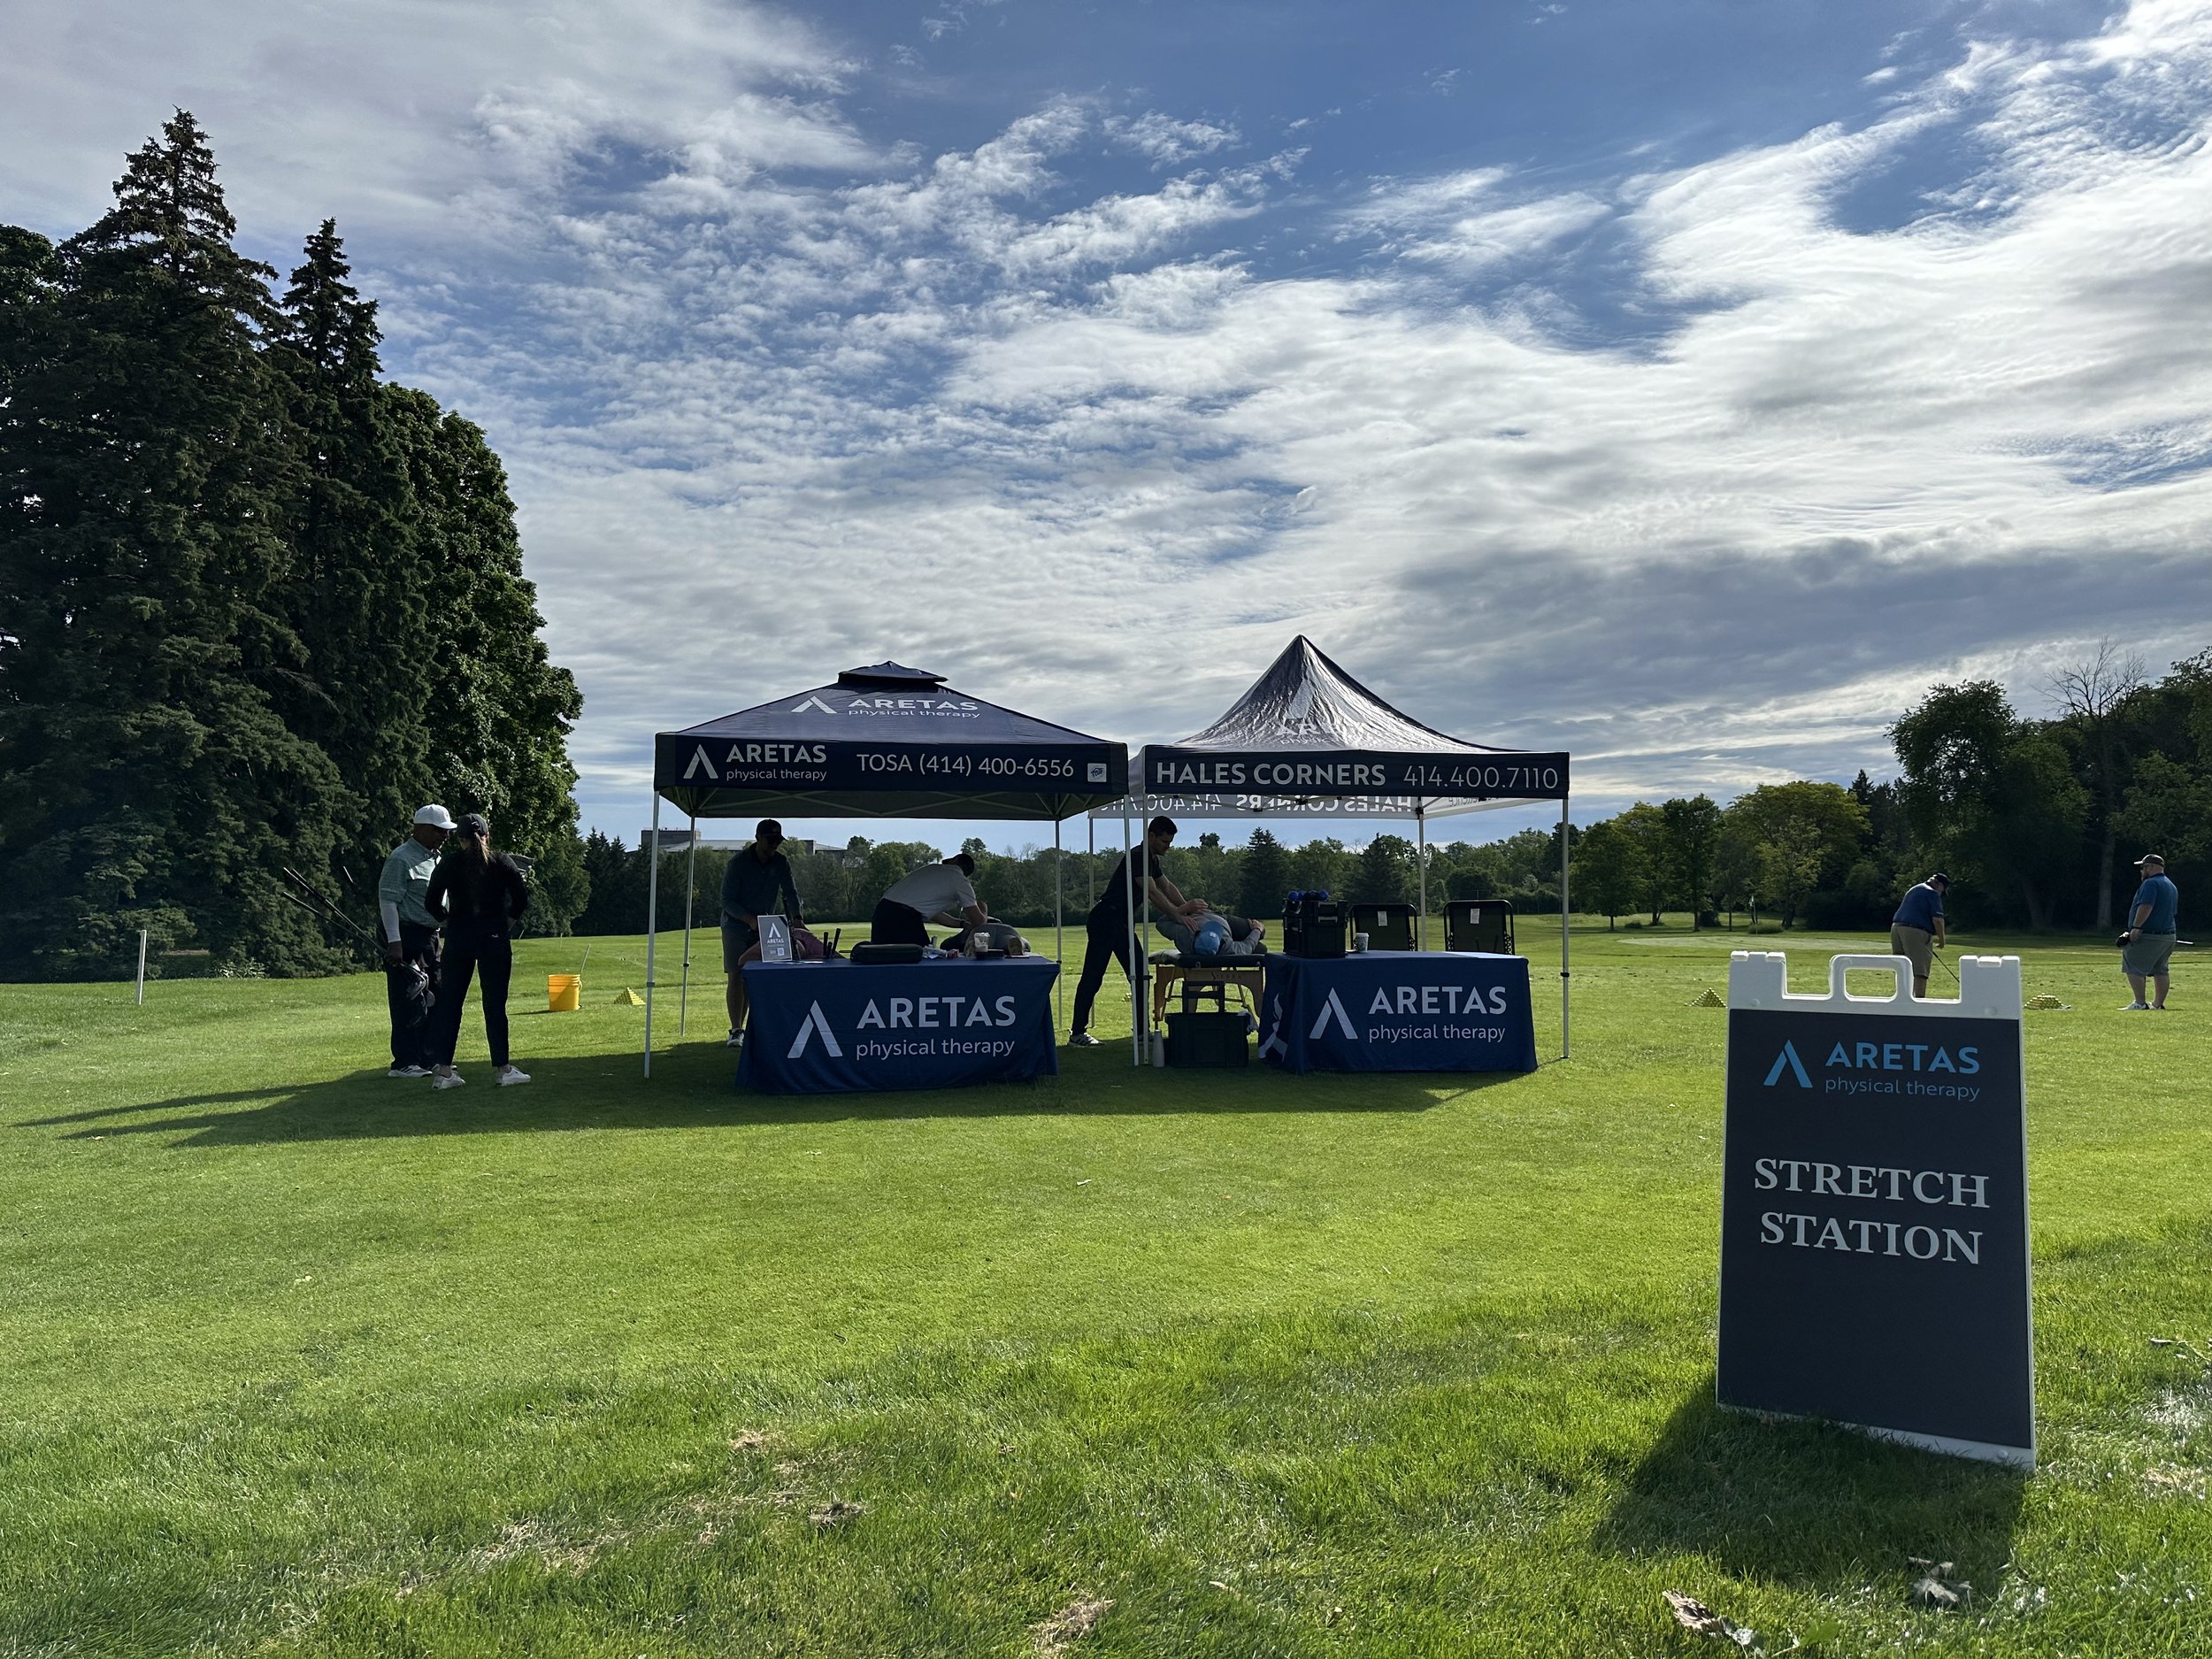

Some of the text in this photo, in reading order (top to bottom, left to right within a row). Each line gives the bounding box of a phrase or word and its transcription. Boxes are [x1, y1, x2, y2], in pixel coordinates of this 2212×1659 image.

[848, 699, 979, 710] ARETAS
[726, 744, 826, 764] ARETAS
[856, 754, 913, 772] TOSA
[919, 754, 972, 777] (414)
[979, 757, 1074, 777] 400-6556
[726, 768, 827, 782] physical therapy
[1156, 762, 1558, 789] HALES CORNERS 414.400.7110
[856, 995, 1016, 1029] ARETAS
[1368, 986, 1507, 1015] ARETAS
[1369, 1024, 1506, 1043] physical therapy
[856, 1039, 1015, 1061] physical therapy
[1825, 1041, 1980, 1074] ARETAS
[1825, 1076, 1980, 1102] physical therapy
[1755, 1158, 1990, 1209] STRETCH
[1760, 1211, 1983, 1265] STATION
